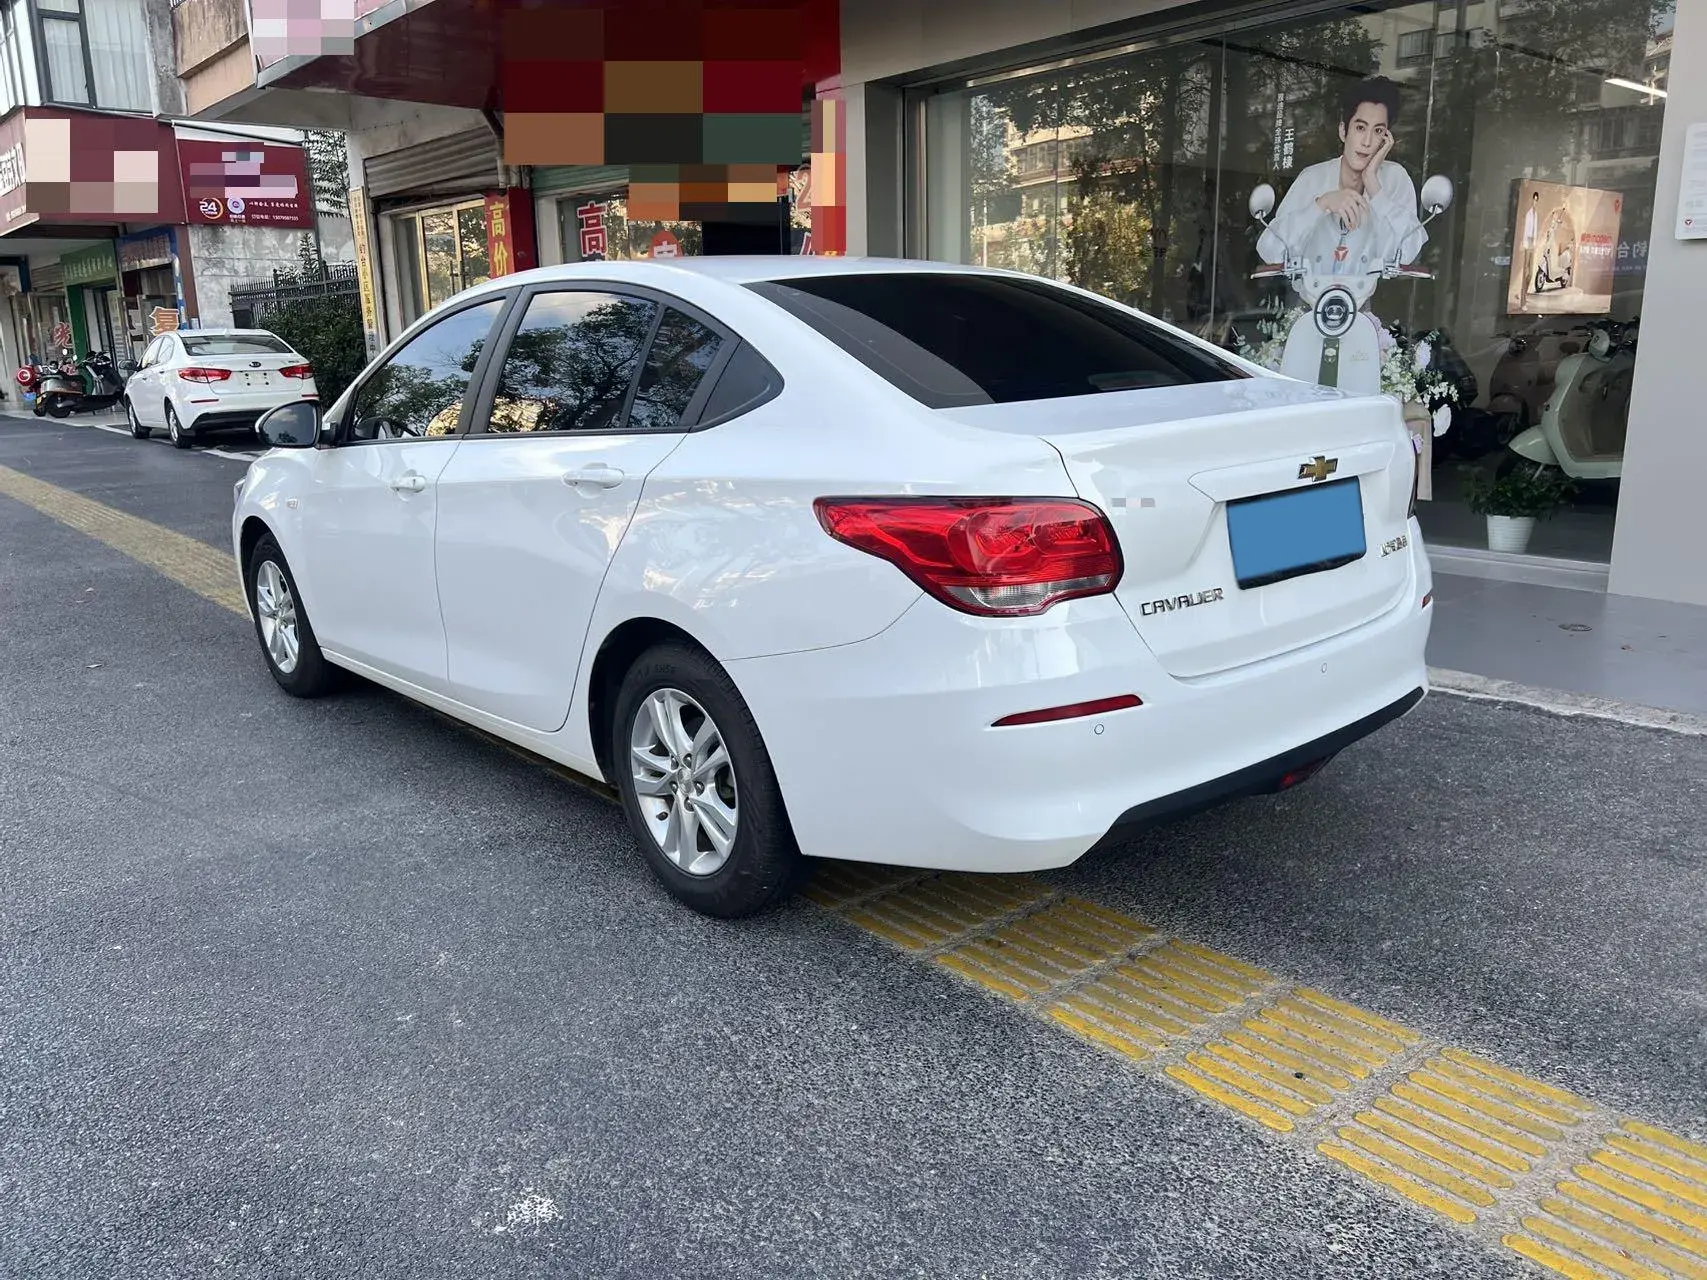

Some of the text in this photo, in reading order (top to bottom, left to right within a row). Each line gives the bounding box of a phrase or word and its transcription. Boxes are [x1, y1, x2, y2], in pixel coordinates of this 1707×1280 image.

[199, 201, 217, 212] 24
[489, 202, 508, 276] 高价
[577, 201, 608, 257] 高
[1141, 588, 1224, 615] CAVALIER
